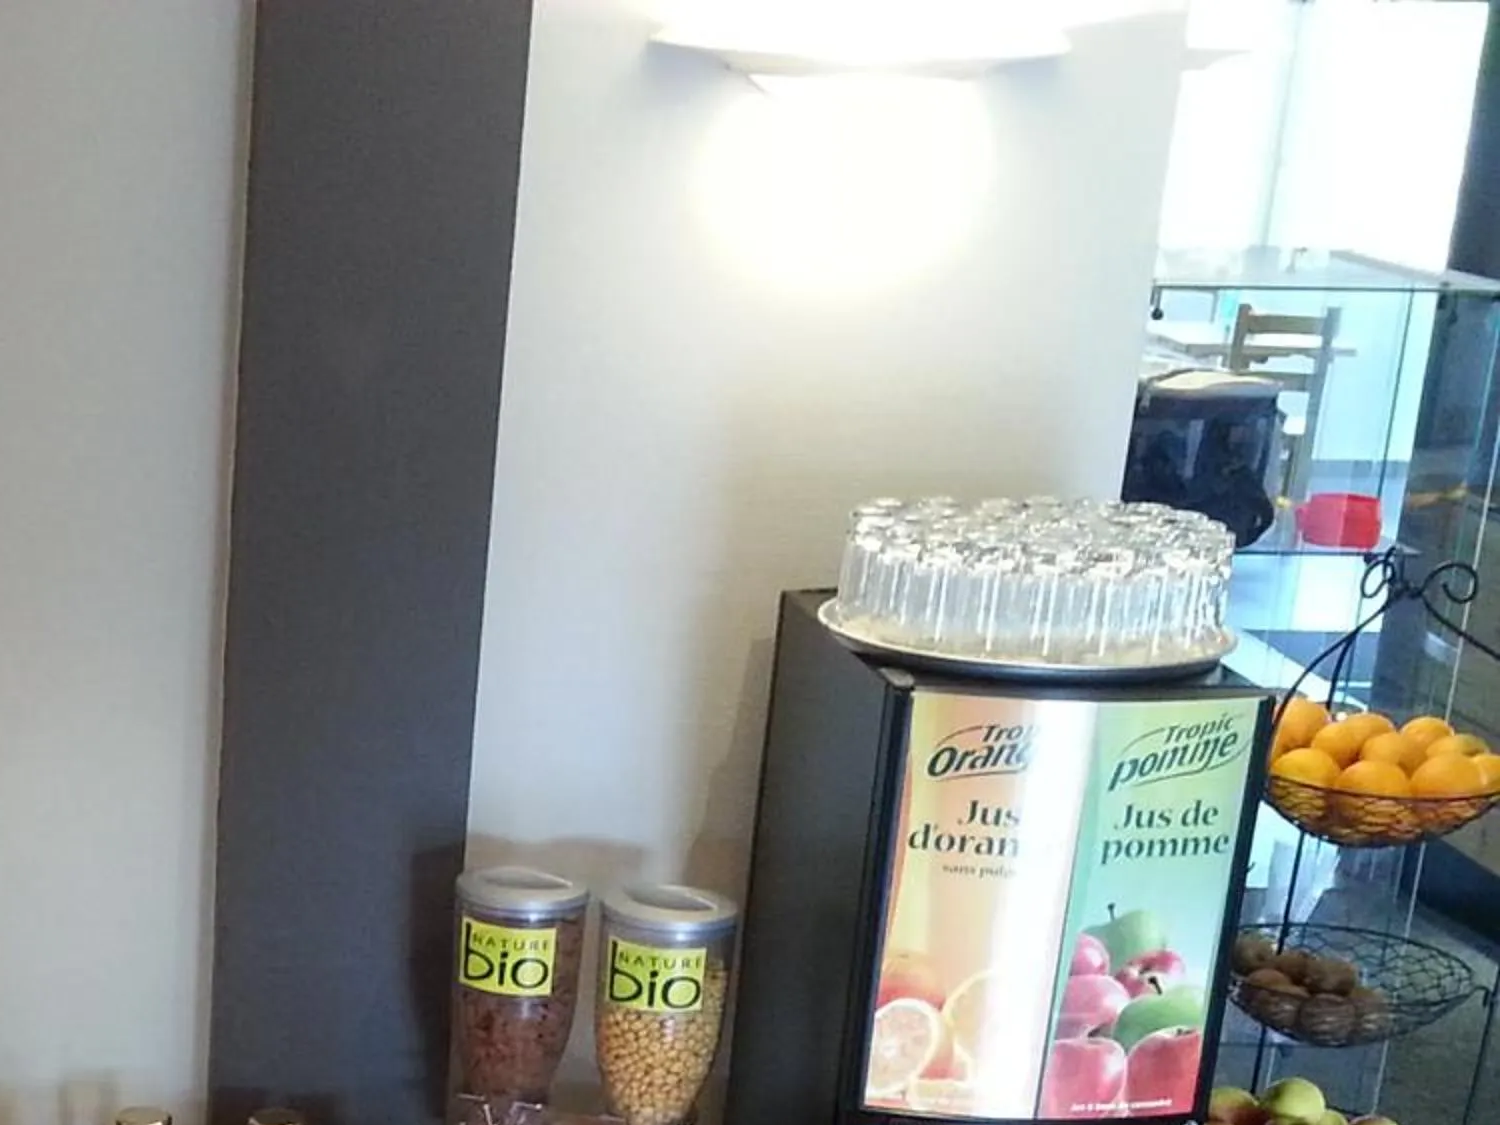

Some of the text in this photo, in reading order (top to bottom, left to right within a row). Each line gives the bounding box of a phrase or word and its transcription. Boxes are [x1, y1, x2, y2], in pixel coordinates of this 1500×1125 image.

[1164, 713, 1234, 744] Tropic
[1108, 732, 1239, 792] pomme
[956, 800, 1019, 827] Jus
[1113, 800, 1219, 830] Jus de
[1101, 834, 1230, 865] pomme
[464, 922, 549, 988] bio
[609, 940, 701, 1009] bio
